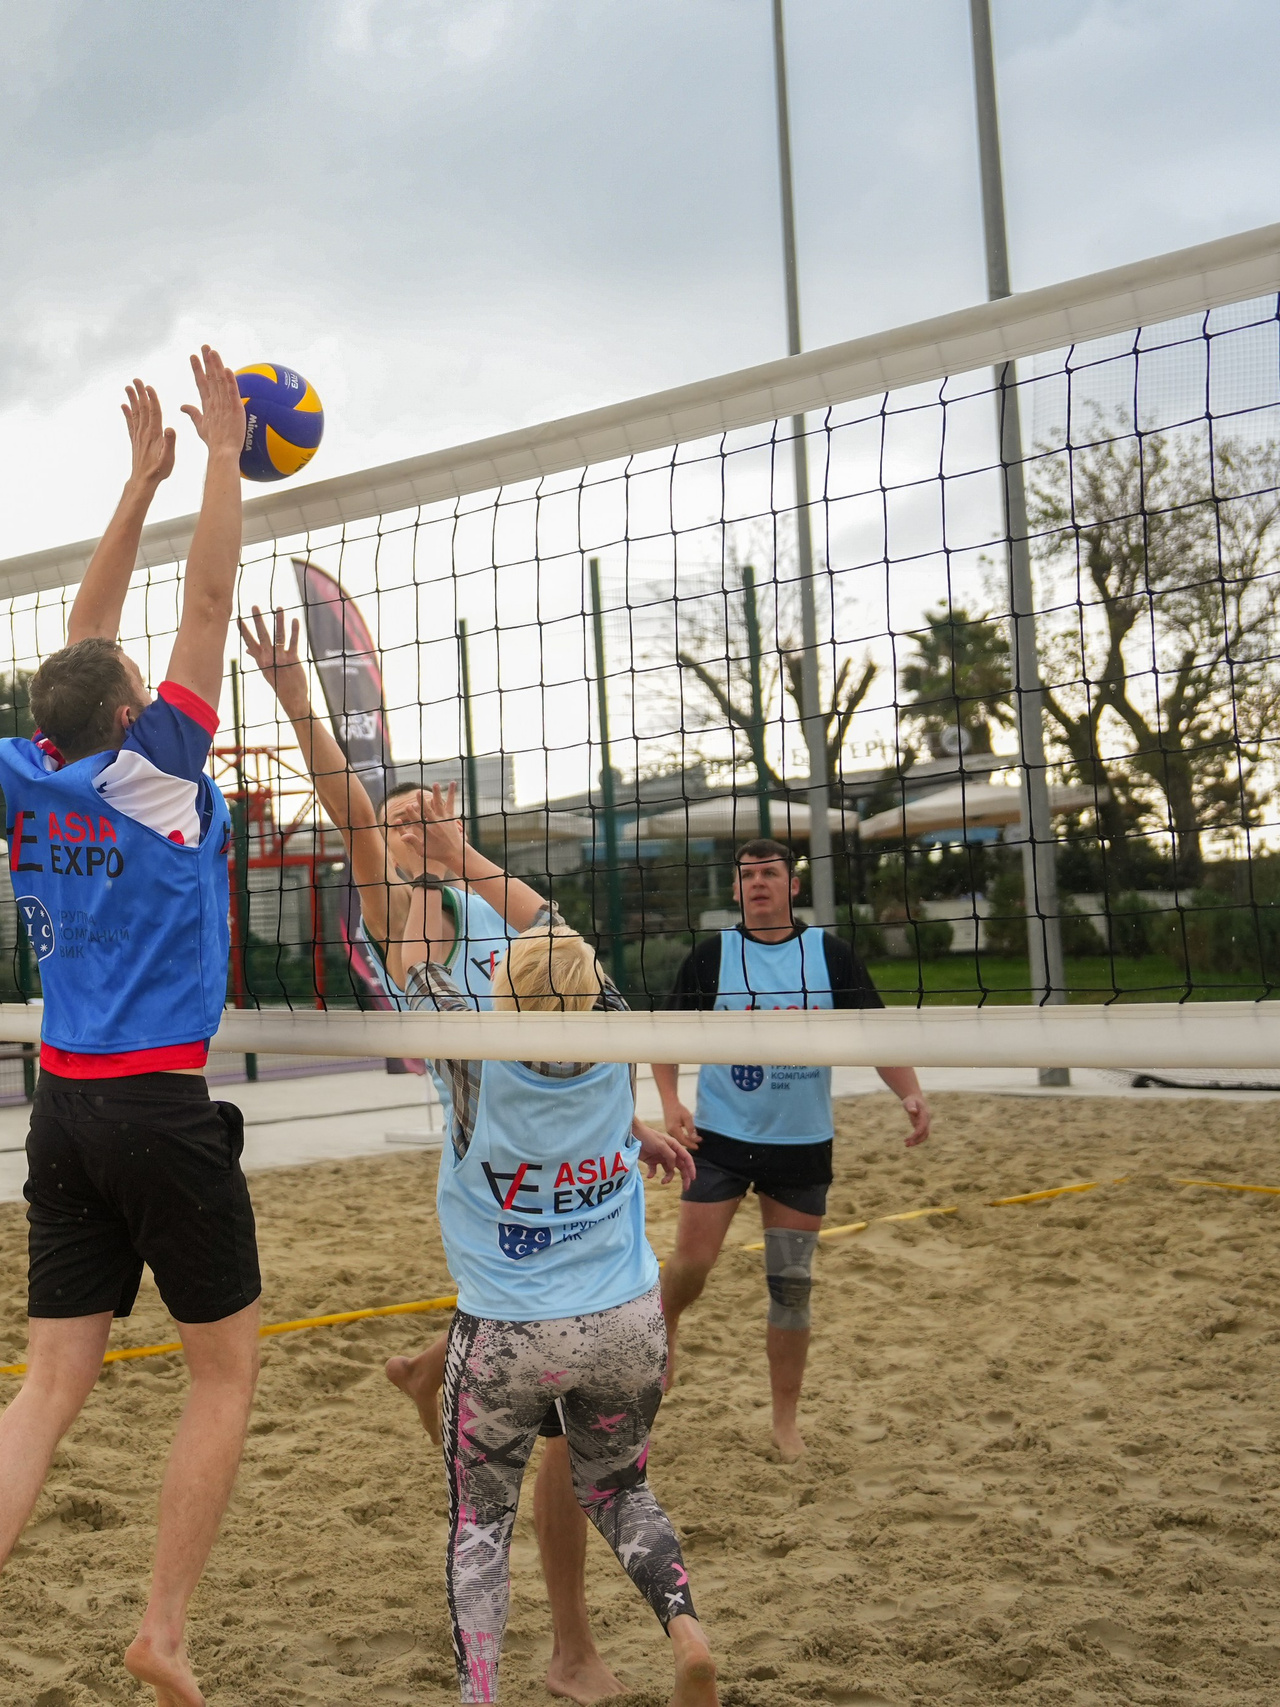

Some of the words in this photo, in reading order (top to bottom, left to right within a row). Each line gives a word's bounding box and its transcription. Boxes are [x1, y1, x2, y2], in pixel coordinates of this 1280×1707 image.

[48, 811, 117, 844] ASIA
[50, 844, 124, 879] EXPO
[60, 946, 85, 959] ВИК
[770, 1069, 820, 1080] КОМПАНИЙ
[770, 1082, 791, 1090] ВИК
[554, 1151, 630, 1189] ASIA
